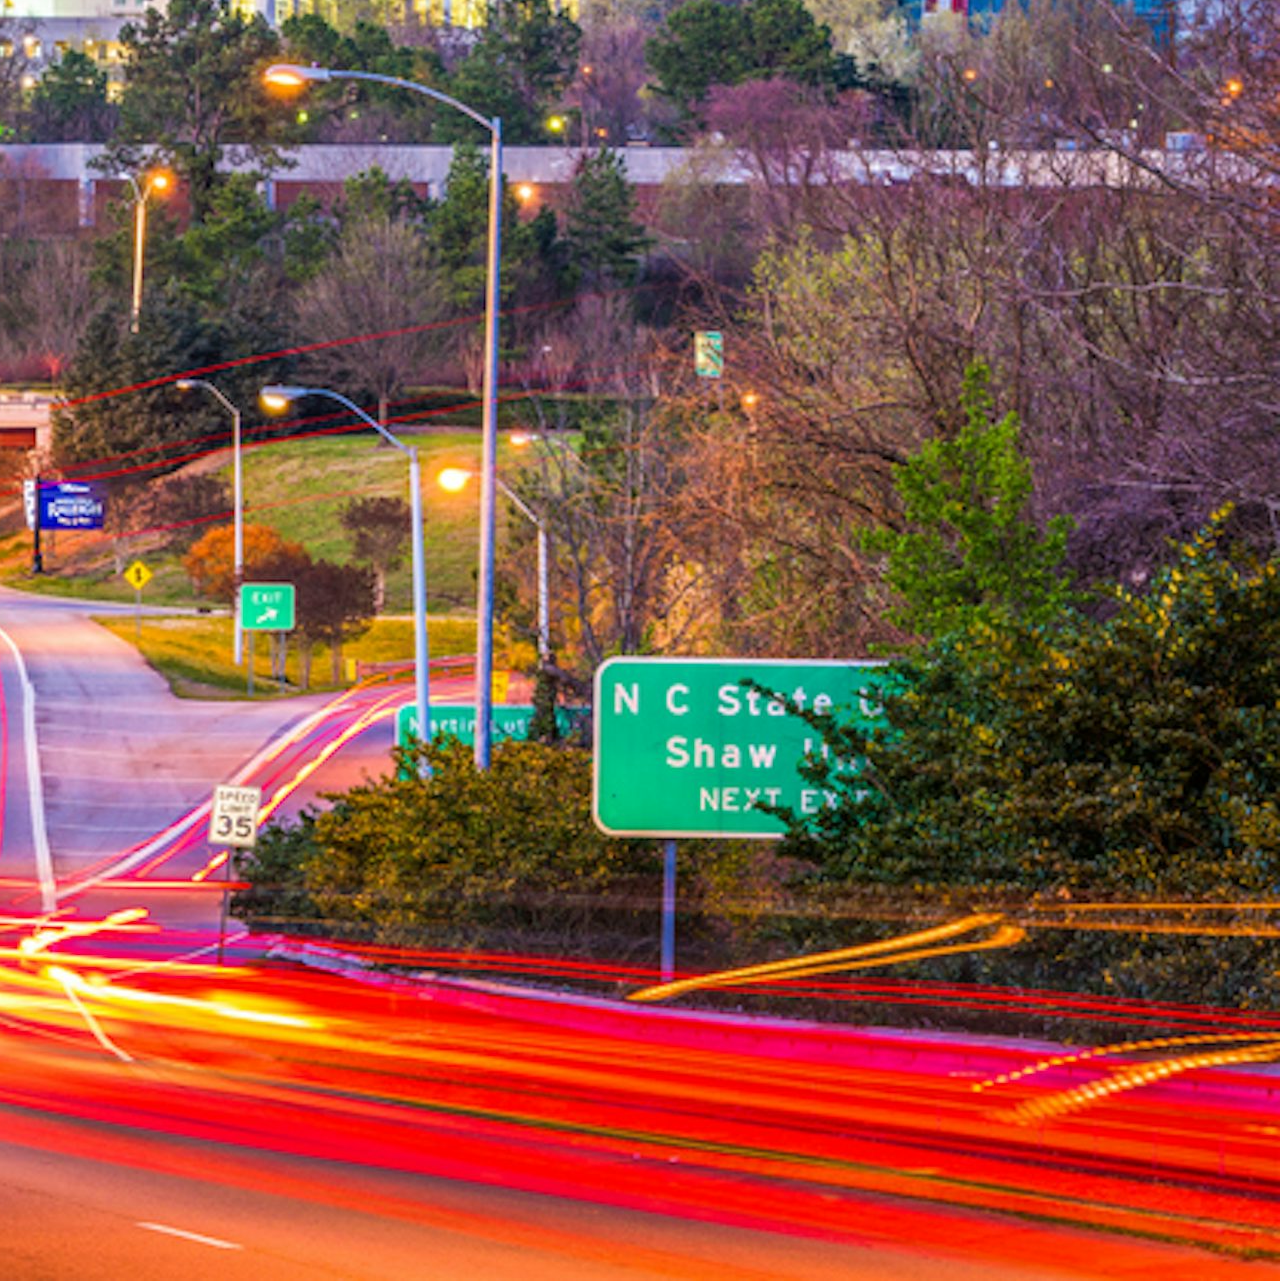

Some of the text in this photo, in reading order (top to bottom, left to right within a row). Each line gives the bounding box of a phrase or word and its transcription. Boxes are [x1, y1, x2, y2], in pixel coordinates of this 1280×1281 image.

[251, 591, 283, 605] EXIT
[614, 683, 639, 715] N
[666, 684, 690, 716] C
[718, 685, 833, 716] State
[666, 736, 777, 768] Shaw
[219, 791, 256, 803] SPEED
[700, 787, 782, 811] NEXT
[220, 804, 251, 813] LIMIT
[217, 815, 252, 837] 35
